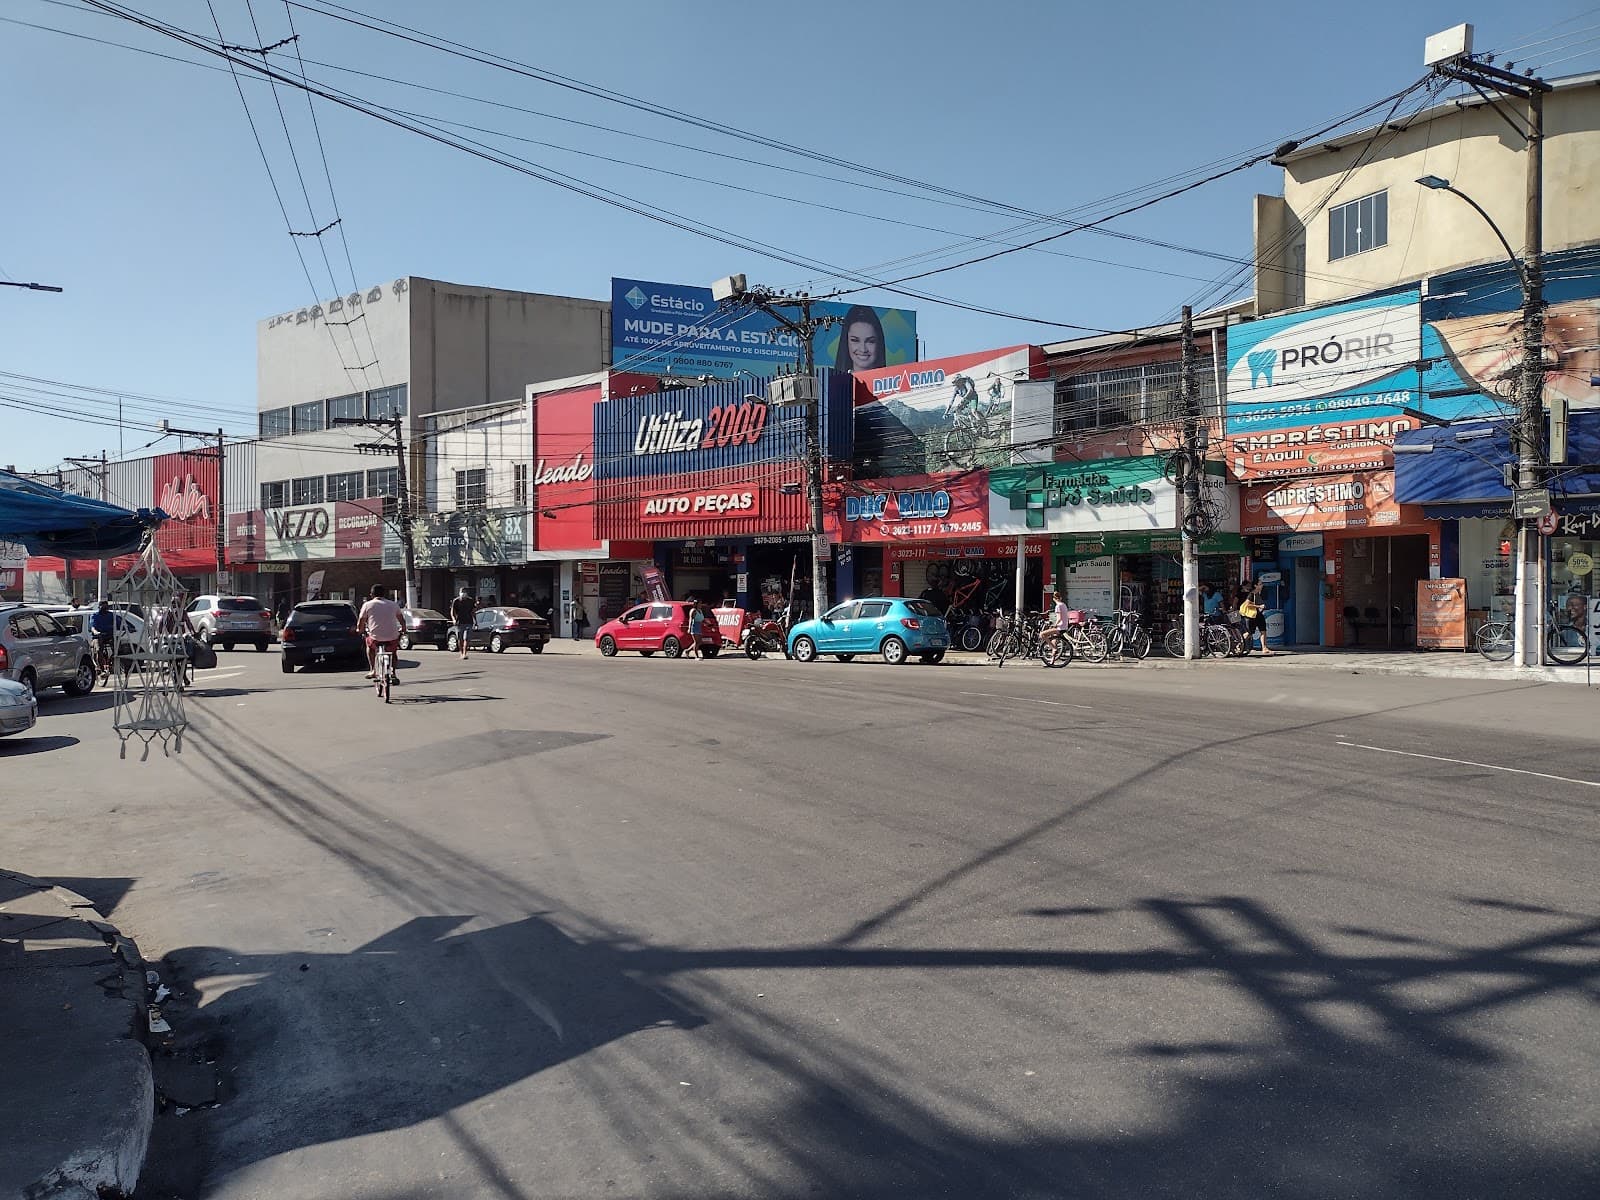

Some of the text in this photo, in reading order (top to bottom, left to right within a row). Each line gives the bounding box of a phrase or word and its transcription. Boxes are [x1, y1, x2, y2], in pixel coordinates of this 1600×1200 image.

[650, 294, 705, 312] Estácio
[624, 319, 674, 336] MUDE
[677, 324, 722, 340] PARA
[725, 329, 738, 342] A
[624, 335, 639, 343] ATÉ
[754, 348, 798, 358] DISCIPLINAS
[1281, 332, 1394, 371] PRÓRIR
[673, 357, 695, 365] 0800
[714, 360, 734, 369] 6767
[634, 402, 767, 456] Utiliza 2000
[1233, 419, 1412, 453] EMPRÉSTIMO
[644, 492, 753, 514] AUTO PEÇAS
[1087, 485, 1153, 506] Saúde
[1267, 481, 1365, 508] EMPRÉSTIMO
